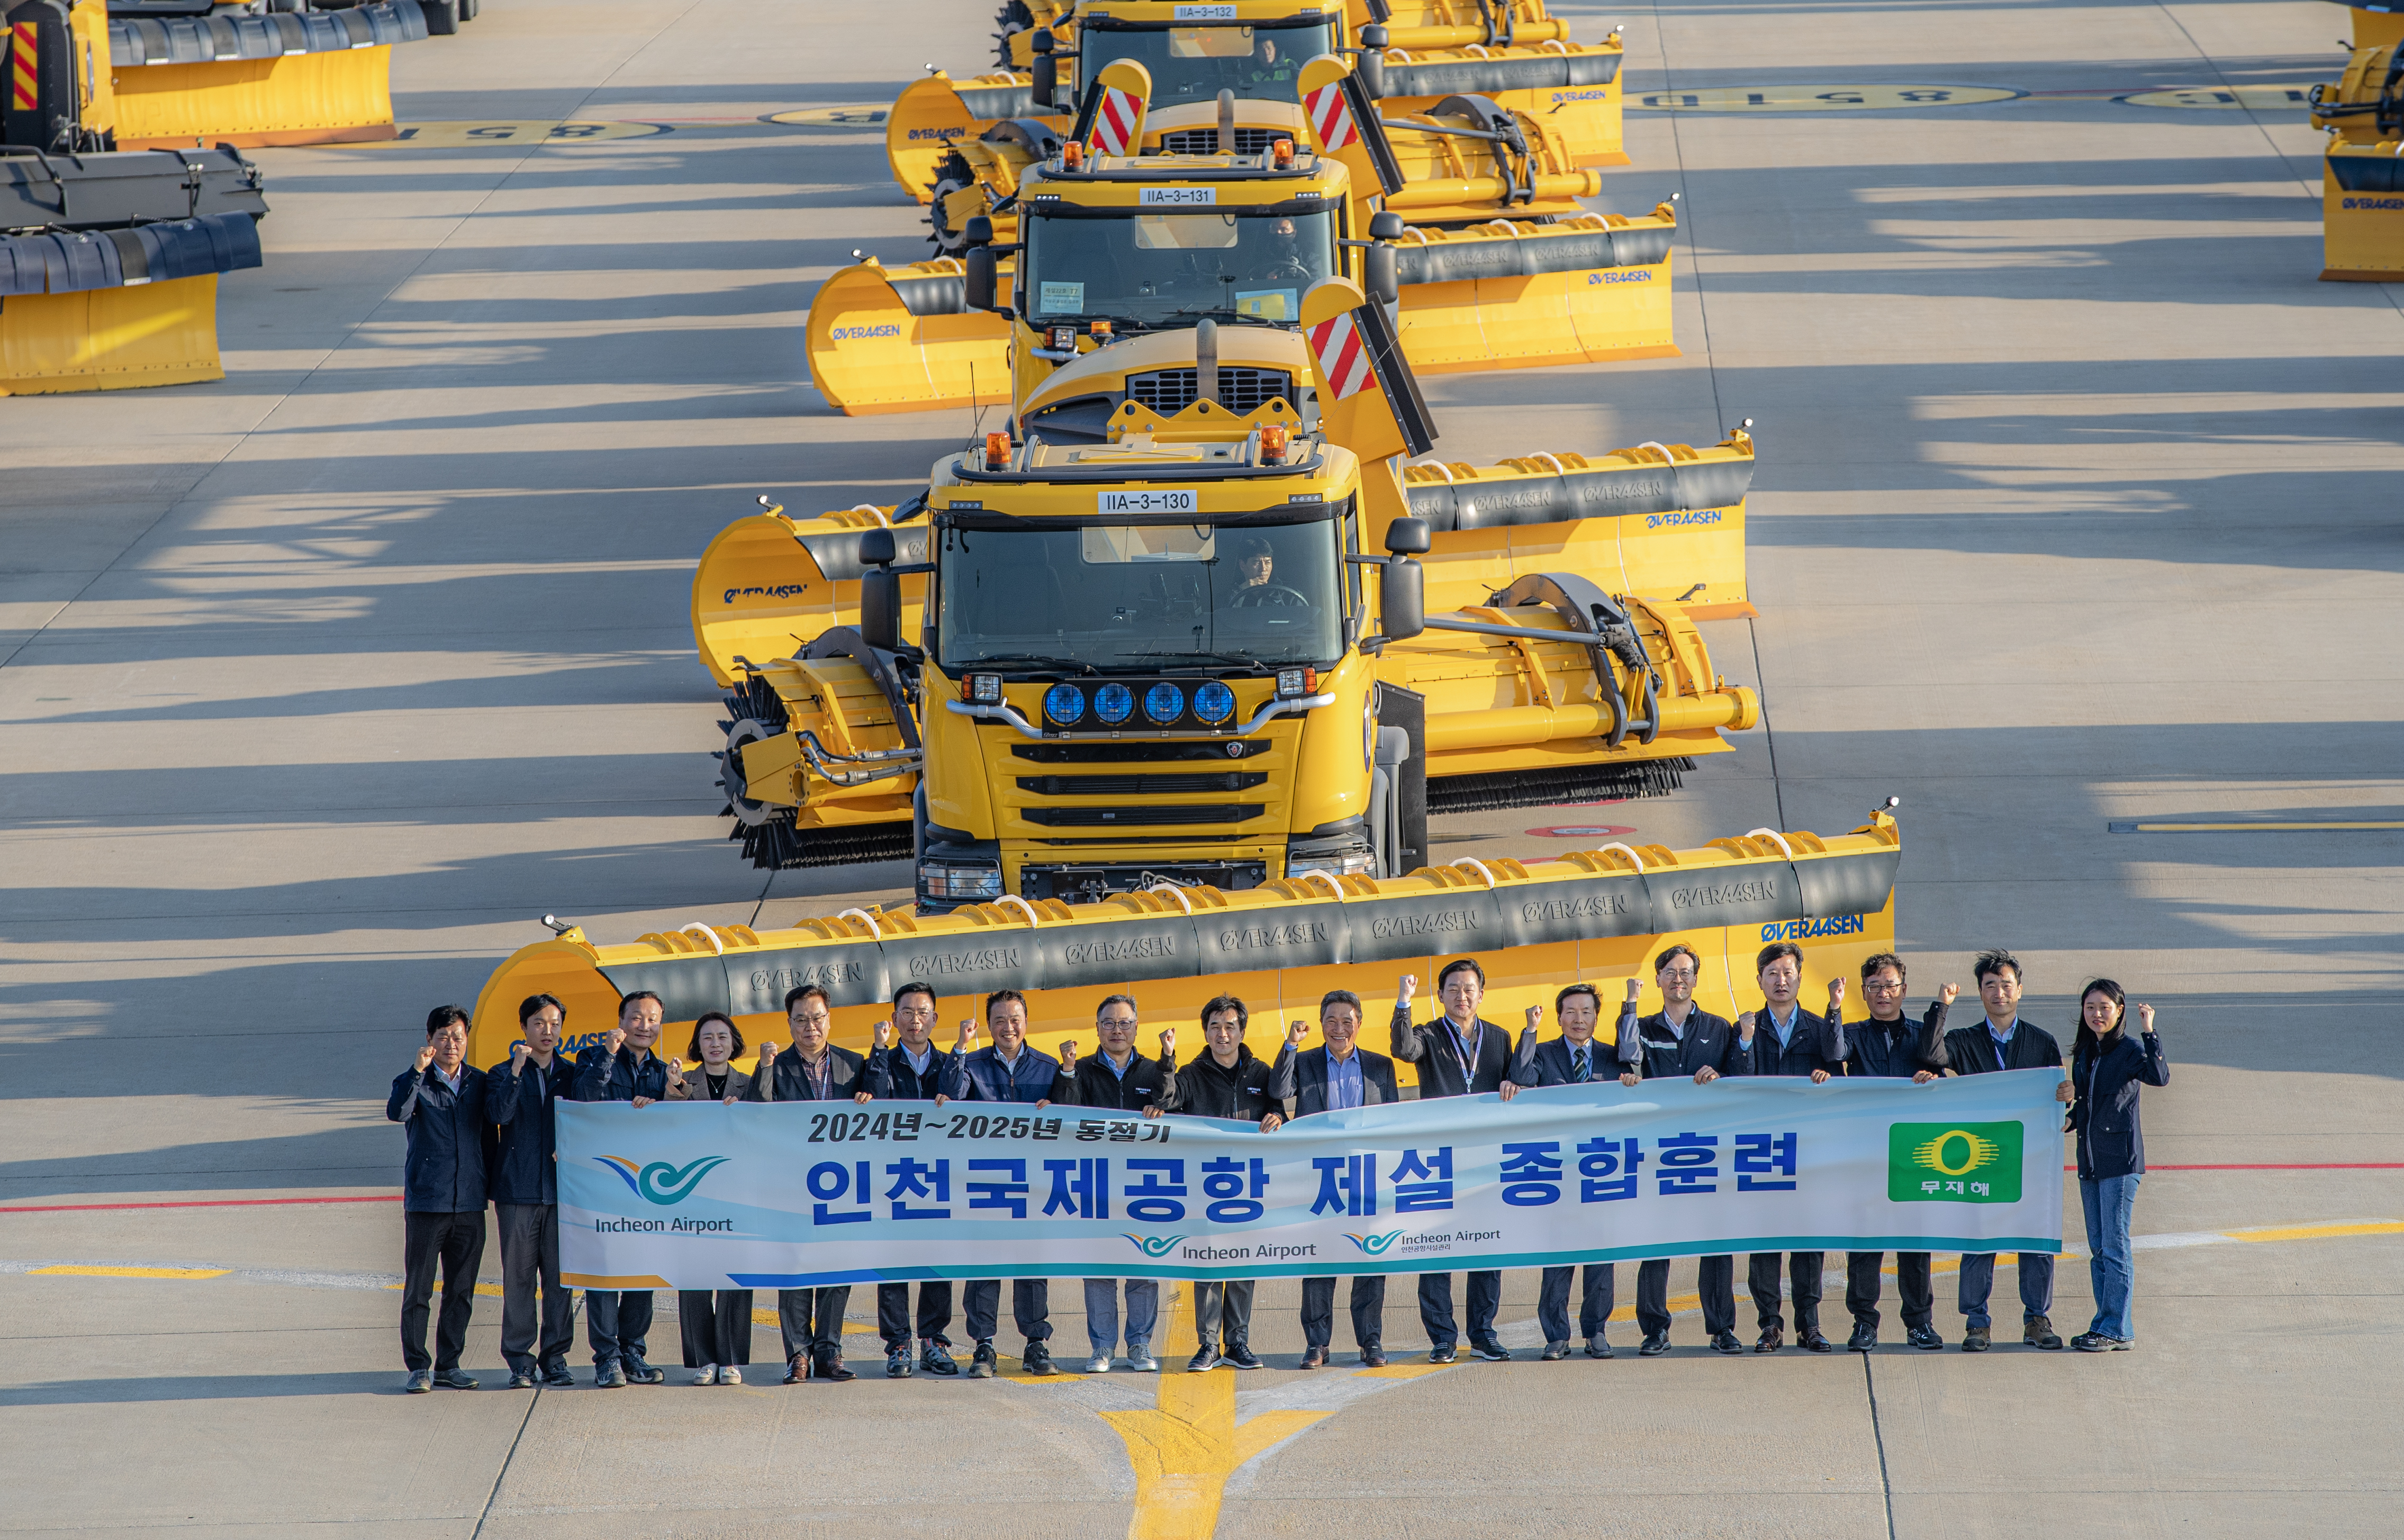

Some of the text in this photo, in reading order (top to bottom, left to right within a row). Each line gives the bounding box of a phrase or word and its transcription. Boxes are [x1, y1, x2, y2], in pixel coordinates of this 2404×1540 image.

[1180, 6, 1232, 17] IIA-3-132
[1146, 189, 1209, 204] IIA-3-131
[1588, 270, 1652, 285] ØVERAASEN
[833, 324, 900, 340] ØVERAASEN
[1106, 493, 1190, 510] IIA-3-130
[1646, 510, 1722, 529] ØVERAASEN
[1671, 881, 1776, 908] ØVERAASEN
[1523, 894, 1628, 922] ØVERAASEN
[1372, 910, 1479, 938] ØVERAASEN
[1760, 913, 1864, 943] ØVERAASEN
[1220, 922, 1328, 952] ØVERAASEN
[1065, 936, 1175, 966] ØVERAASEN
[909, 947, 1021, 978] ØVERAASEN
[751, 962, 865, 992] ØVERAASEN
[807, 1112, 1171, 1144] 2024년~2025년 동절기
[806, 1131, 1797, 1226] 인천국제공항 제설 종합훈련
[1921, 1180, 1990, 1197] 무재해
[595, 1216, 733, 1235] Incheon Airport
[1402, 1229, 1501, 1245] Incheon Airport
[1182, 1243, 1317, 1260] Incheon Airport
[1401, 1244, 1451, 1253] 인천공항시설관리
